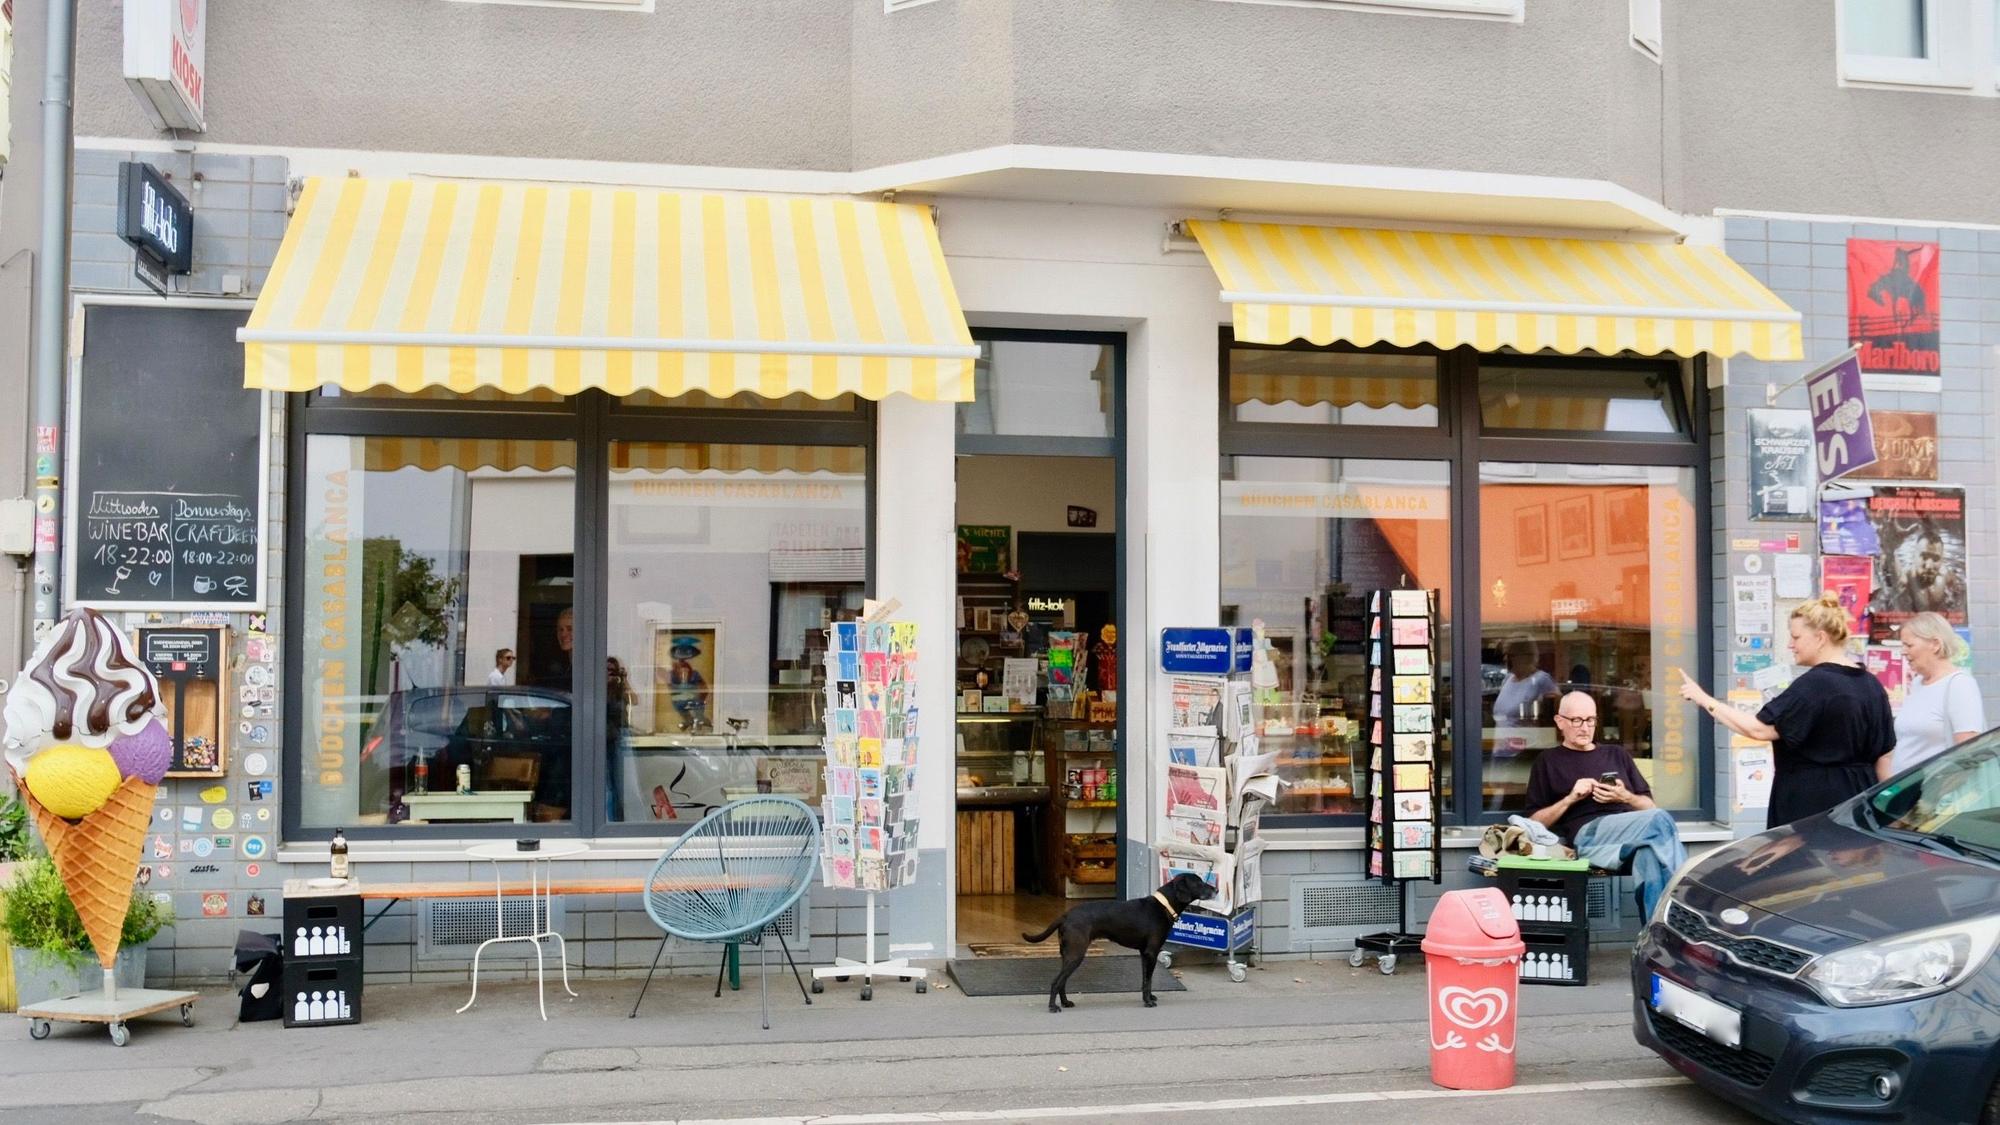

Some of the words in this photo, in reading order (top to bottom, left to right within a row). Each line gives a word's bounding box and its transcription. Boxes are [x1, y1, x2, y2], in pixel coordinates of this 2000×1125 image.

[172, 34, 202, 108] KIOSK
[321, 469, 348, 651] CASABLANCA
[1662, 498, 1684, 657] CASABLANCA
